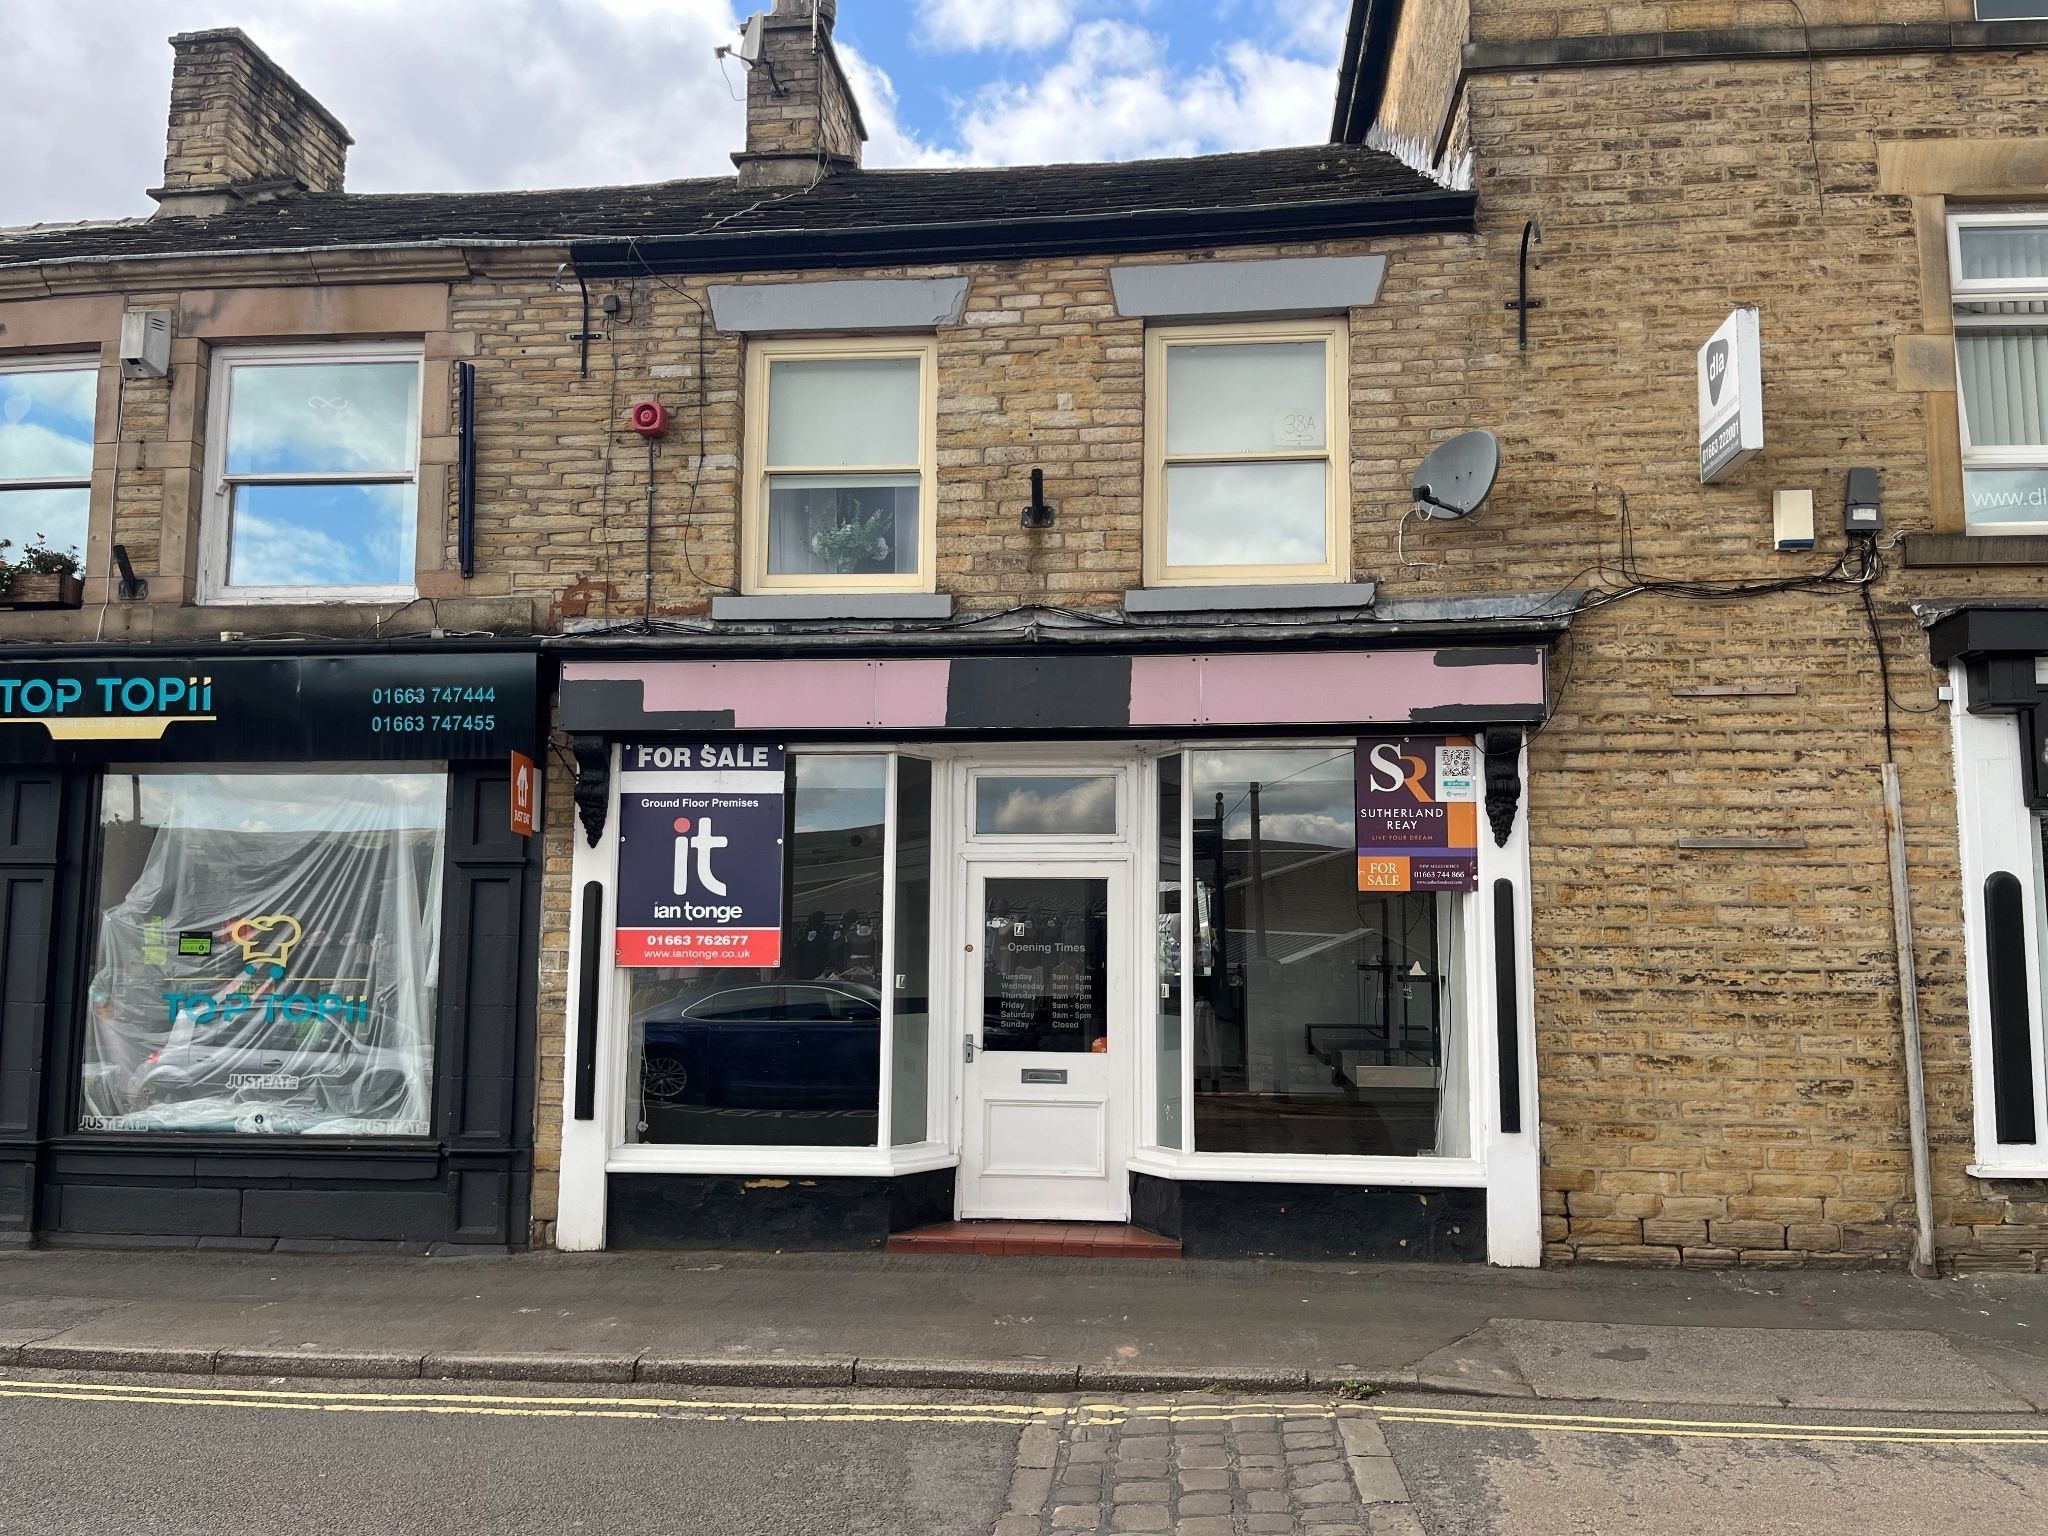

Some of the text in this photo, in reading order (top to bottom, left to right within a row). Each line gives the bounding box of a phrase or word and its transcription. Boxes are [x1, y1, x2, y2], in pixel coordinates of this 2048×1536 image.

[1709, 352, 1725, 382] dla
[1284, 414, 1316, 434] 38A
[0, 676, 212, 713] TOP TOPii
[371, 686, 496, 704] 01663 747444
[371, 715, 495, 732] 01663 747455
[638, 746, 769, 768] FOR SALE
[1370, 743, 1436, 803] SR
[641, 798, 758, 808] Ground Floor Premises
[1360, 808, 1444, 818] SUTHERLAND
[1387, 820, 1418, 830] REAY
[673, 816, 728, 897] it
[1370, 863, 1397, 874] FOR
[1367, 875, 1400, 886] SALE
[654, 901, 743, 924] ian tonge
[647, 935, 748, 946] 01663 762677
[1007, 942, 1086, 954] Opening Times
[644, 949, 751, 960] www.iantonge.co.uk
[1001, 973, 1033, 981] Tuesday
[1001, 983, 1044, 991] Wednesday
[1001, 992, 1036, 1000] Thursday
[161, 992, 250, 1023] TOP
[1001, 1002, 1025, 1010] Friday
[1001, 1012, 1035, 1020] Saturday
[1001, 1021, 1030, 1029] Sunday
[1052, 1021, 1079, 1029] Closed
[227, 1075, 261, 1088] JUST
